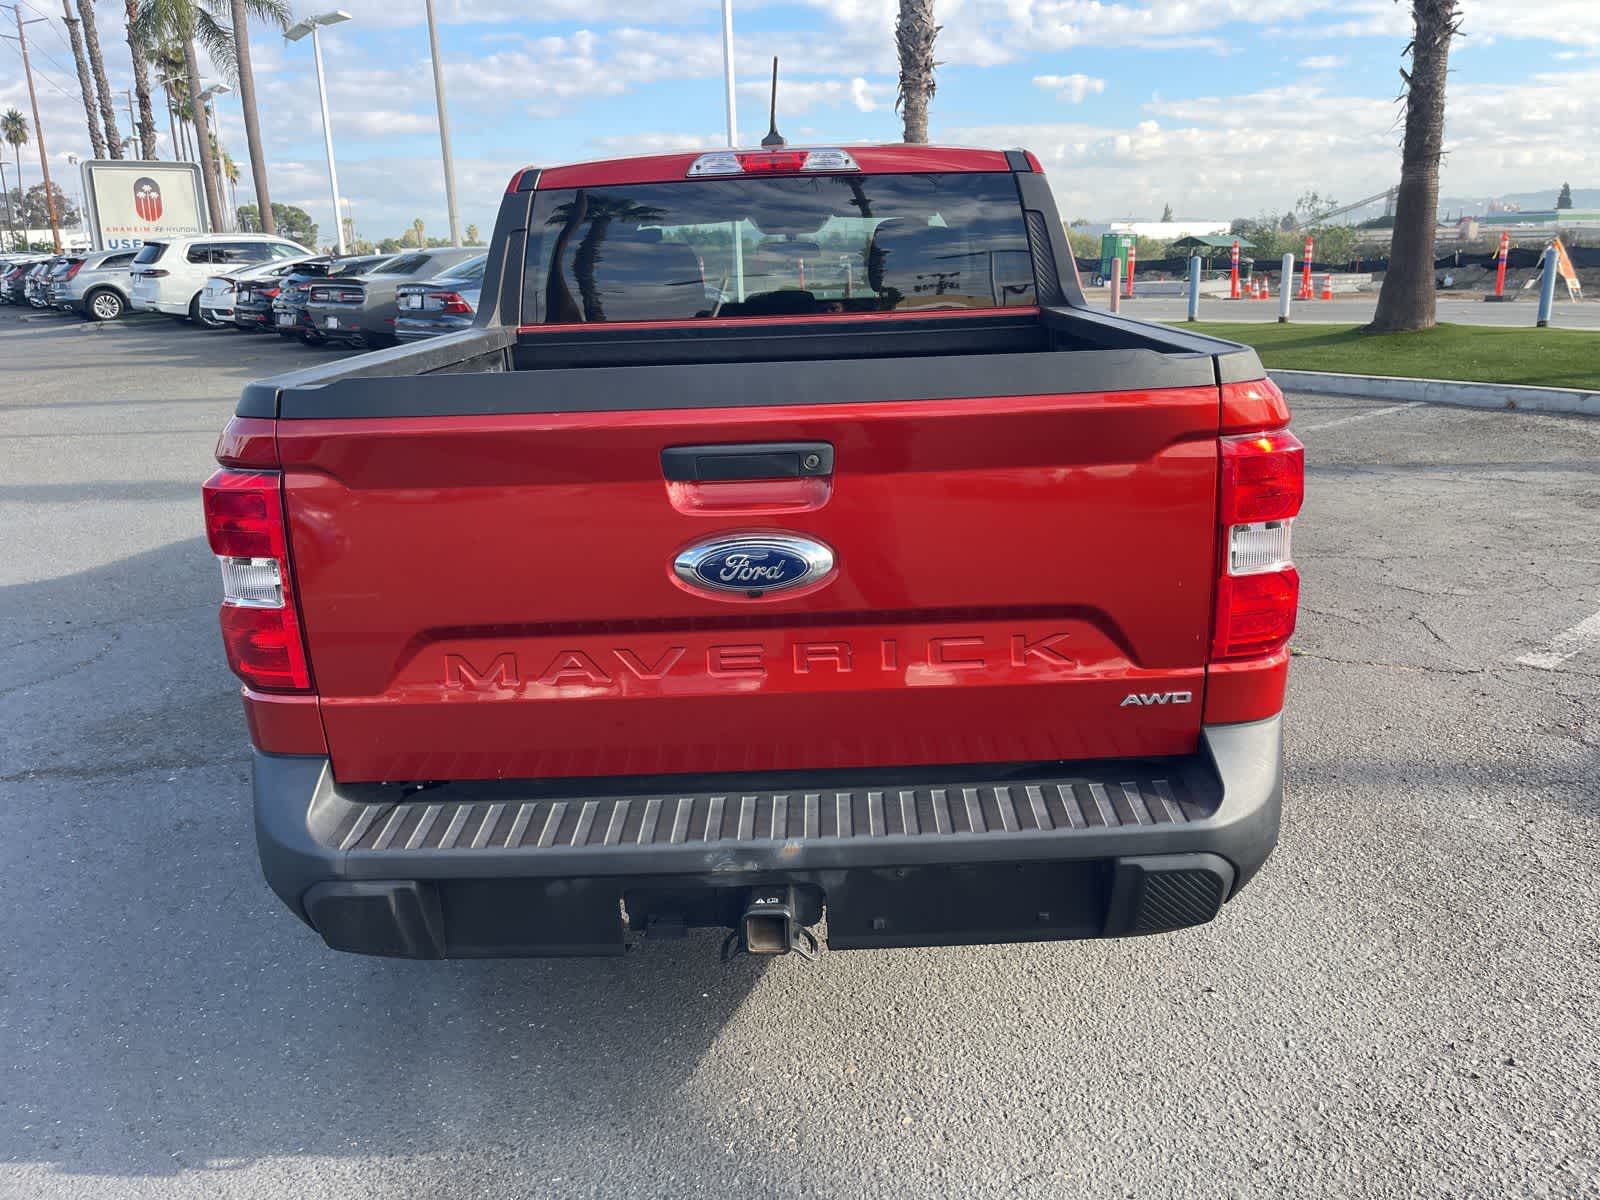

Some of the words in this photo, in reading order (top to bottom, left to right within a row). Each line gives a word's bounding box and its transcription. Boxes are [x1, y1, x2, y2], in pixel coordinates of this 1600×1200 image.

[719, 553, 785, 582] Ford
[445, 632, 1074, 687] MAVERICK
[1120, 691, 1192, 707] AWD
